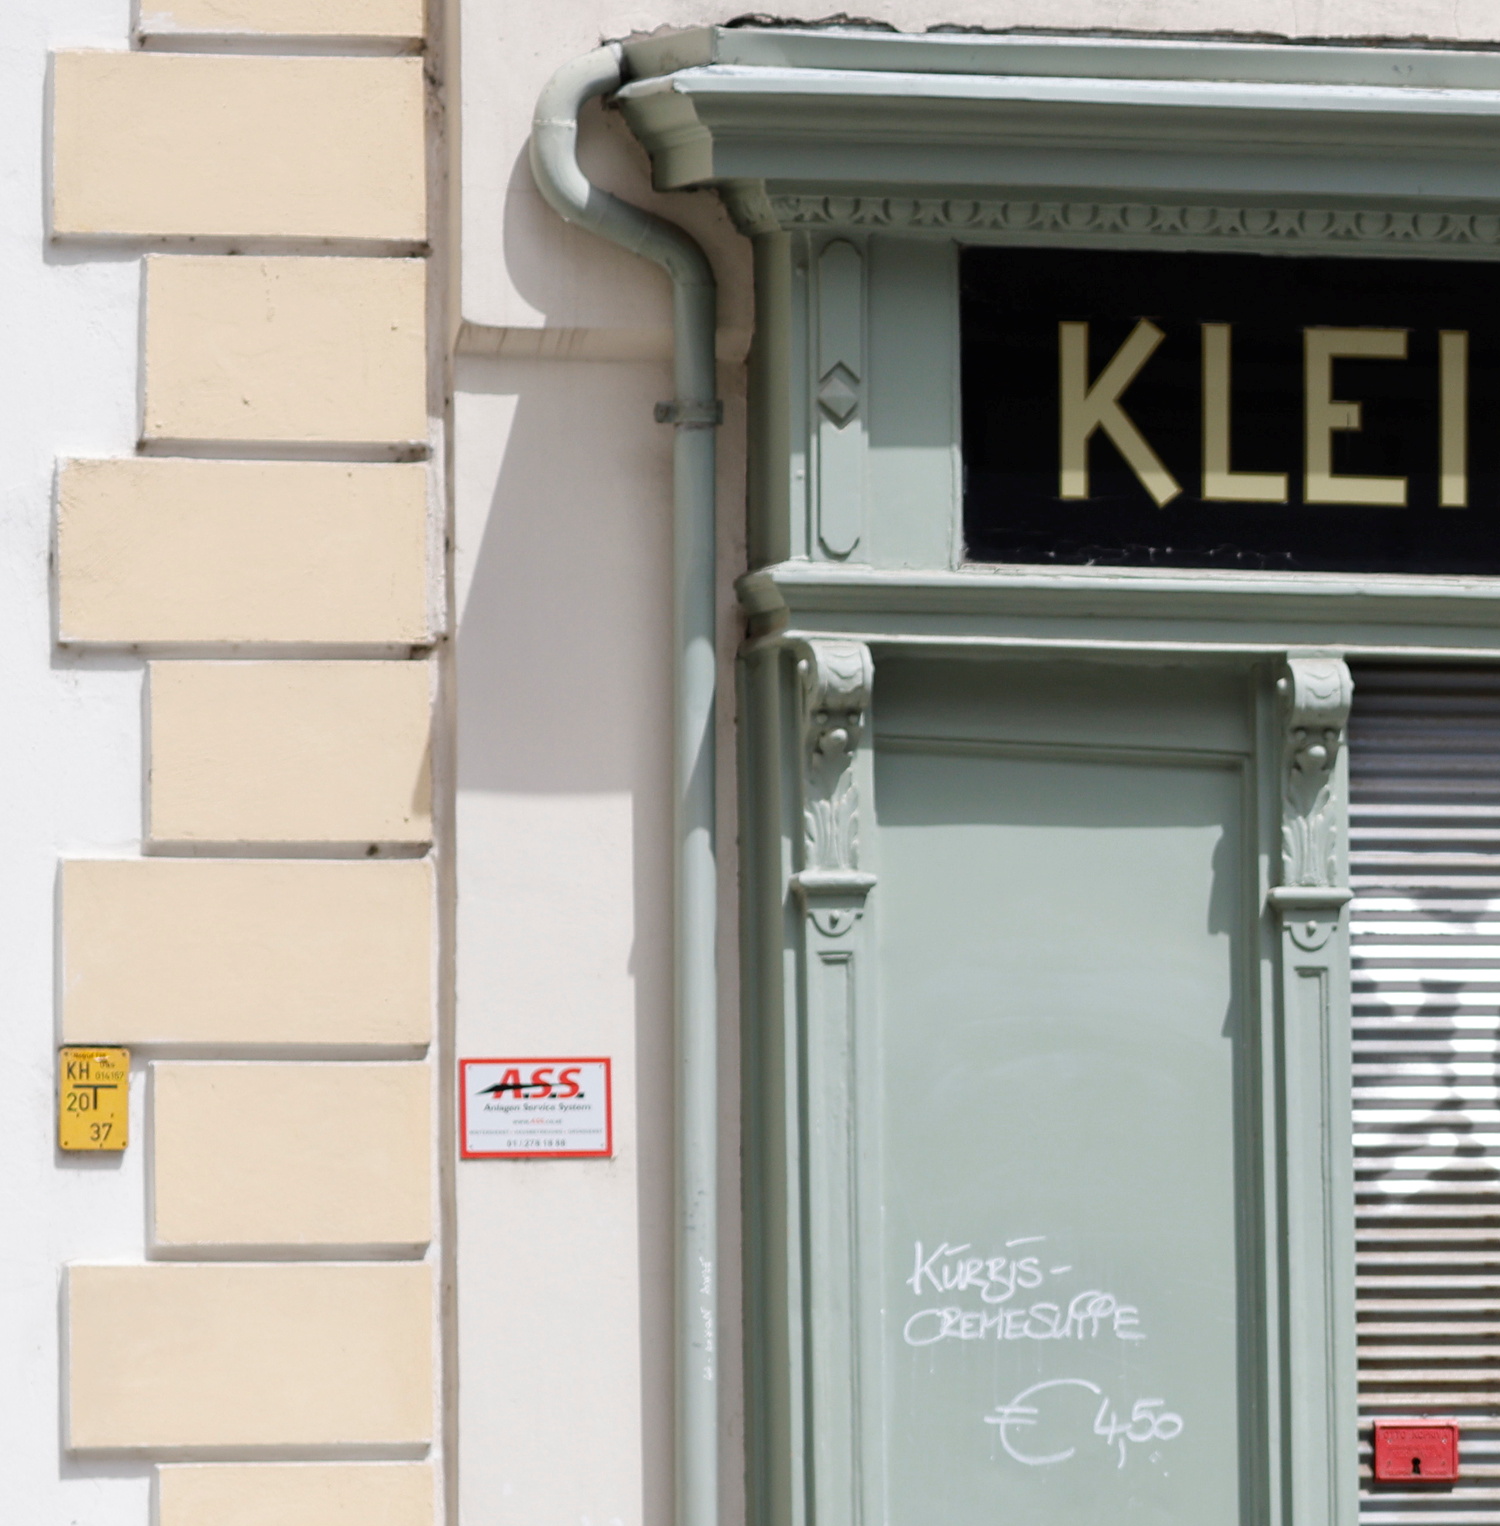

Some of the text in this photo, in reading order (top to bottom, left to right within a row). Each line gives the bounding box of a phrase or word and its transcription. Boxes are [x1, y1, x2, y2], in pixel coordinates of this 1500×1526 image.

[67, 1061, 90, 1080] KH
[66, 1092, 90, 1112] 20
[483, 1103, 591, 1113] Anlagen Service System
[90, 1122, 113, 1141] 37
